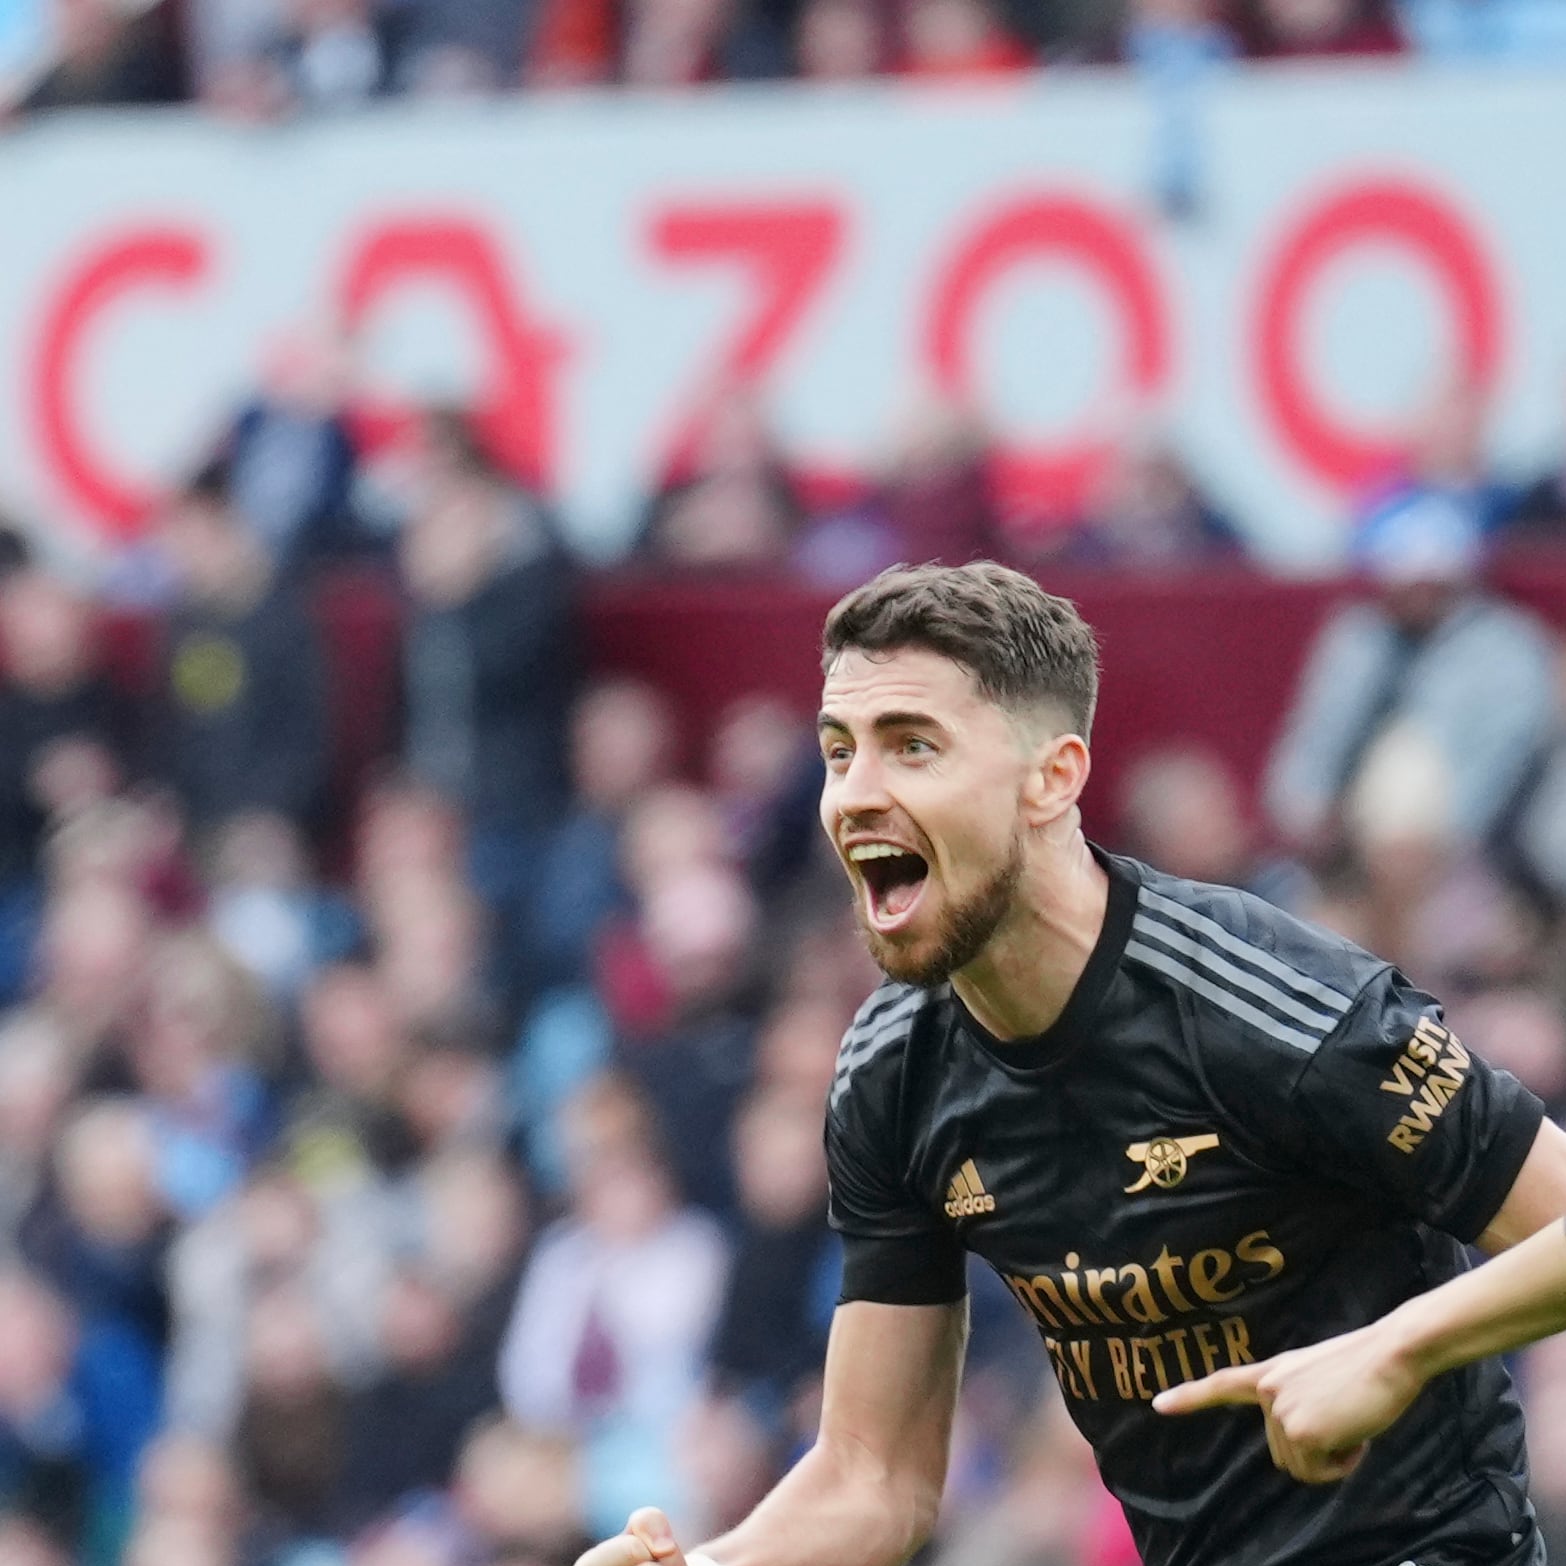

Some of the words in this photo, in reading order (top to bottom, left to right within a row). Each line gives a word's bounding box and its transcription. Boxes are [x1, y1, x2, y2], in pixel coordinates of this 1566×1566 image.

[28, 178, 1506, 545] CAZOO
[1379, 1015, 1449, 1096] VISIT
[1386, 1031, 1471, 1155] RWAN
[944, 1193, 996, 1218] adidas
[1003, 1229, 1285, 1329] mirates
